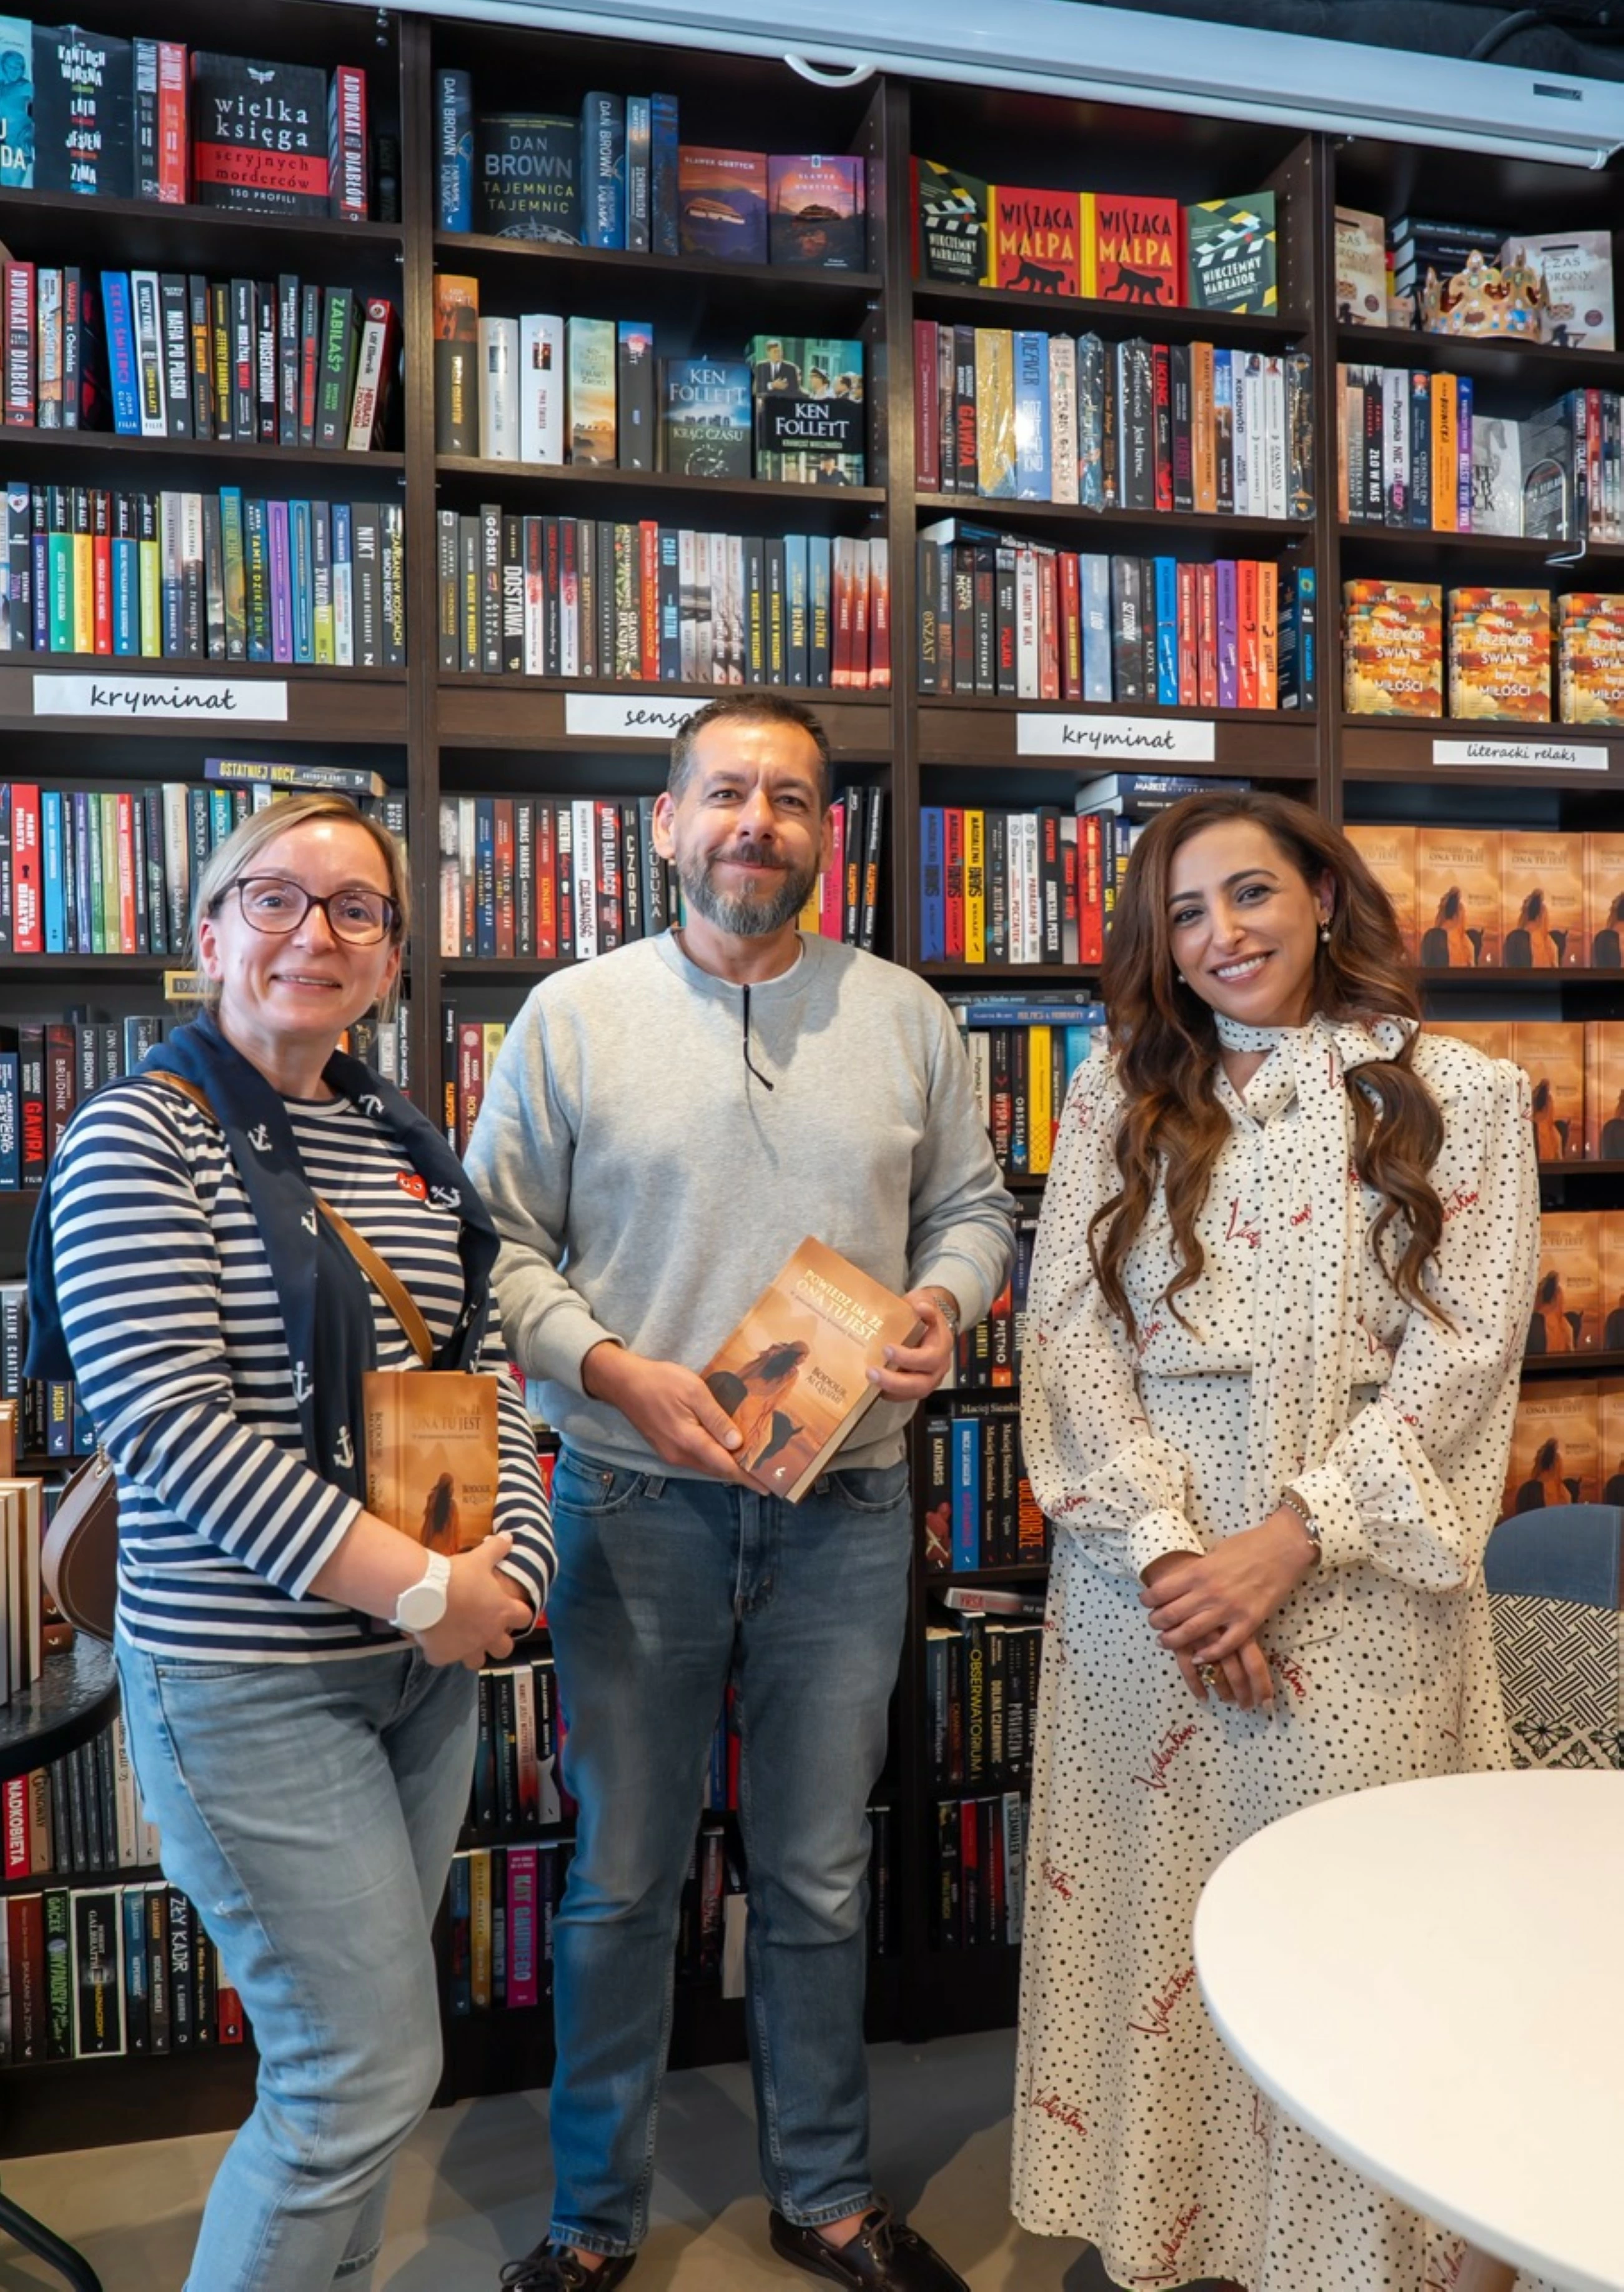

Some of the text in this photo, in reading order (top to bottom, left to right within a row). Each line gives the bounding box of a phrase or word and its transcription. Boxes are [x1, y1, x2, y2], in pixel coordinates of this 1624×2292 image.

[70, 98, 96, 117] LATO
[443, 77, 457, 104] DAN
[215, 96, 309, 124] wielka
[599, 101, 613, 125] DAN
[216, 115, 309, 151] księga
[344, 74, 365, 208] ADWOKAT DIABŁÓW
[443, 107, 456, 156] BROWN
[509, 136, 548, 151] DAN
[215, 149, 310, 173] seryjnych
[484, 154, 573, 179] BROWN
[600, 130, 613, 177] BROWN
[70, 162, 97, 184] ZIMA
[215, 168, 310, 189] morderców
[483, 182, 574, 197] TAJEMNICA
[230, 189, 297, 204] 150 PROFILI
[488, 199, 569, 214] TAJEMNIC
[1001, 199, 1074, 238] WISZĄCA
[1100, 207, 1172, 246] WISZĄCA
[1000, 229, 1074, 260] MAŁPA
[1100, 237, 1173, 267] MAŁPA
[1203, 257, 1262, 283] NIKCZEMNY
[1204, 273, 1255, 295] NARRATOR
[111, 284, 124, 323] SEKTA
[10, 270, 31, 407] ADWOKAT DIABŁÓW
[167, 310, 187, 399] MAFIA PO POLSKU
[690, 369, 726, 384] KEN
[1022, 337, 1040, 386] DEAVER
[669, 383, 746, 405] FOLLETT
[1157, 363, 1169, 405] KING
[775, 418, 849, 438] FOLLETT
[795, 403, 829, 419] KEN
[673, 428, 743, 441] KRĄG CZASU
[958, 404, 975, 467] GAWRA
[1394, 446, 1403, 464] NIC
[1370, 469, 1380, 480] W
[1370, 482, 1380, 503] NAS
[252, 534, 260, 568] TAMTE
[357, 526, 375, 560] NIKT
[486, 516, 499, 566] GÓRSKI
[384, 548, 392, 623] SIMON BECKETT
[504, 565, 523, 637] DOSTAWA
[1022, 583, 1032, 621] SAMOTNY
[394, 595, 403, 646] KOŚCIACH
[1122, 602, 1136, 642] SZTORM
[1371, 628, 1425, 642] PRZEKÓR
[1390, 612, 1407, 623] Na
[628, 612, 638, 660] GŁODNE
[1476, 633, 1533, 648] PRZEKÓR
[1374, 678, 1423, 693] MIŁOŚCI
[220, 762, 268, 780] OSTATNIEJ
[1467, 744, 1577, 762] literacki relaks
[16, 808, 25, 852] MIASTA
[518, 807, 530, 879] THOMAS HARRIS
[972, 816, 981, 863] MAGDALENA
[602, 808, 615, 895] DAVID BALDACCI
[626, 835, 637, 926] CZORT
[1011, 900, 1021, 944] POCZĄTEK
[106, 1029, 117, 1051] DAN
[83, 1029, 94, 1089] DAN BROWN
[56, 1058, 65, 1111] BRUDNIK
[467, 1096, 477, 1118] ROK
[24, 1101, 43, 1163] GAWRA
[804, 1269, 852, 1307] POWIEDZ
[797, 1279, 878, 1341] ONA TU JEST
[994, 1319, 1006, 1364] PIĘTNO
[7, 1346, 19, 1393] CHATTAM
[52, 1385, 65, 1422] JAGODA
[962, 1402, 988, 1415] Maciej
[441, 1417, 481, 1431] TU JEST
[985, 1426, 996, 1456] Maciej
[1001, 1424, 1012, 1454] Maciej
[970, 1649, 982, 1772] OBSERWATORIUM
[1133, 1722, 1197, 1790] Valentino
[7, 1780, 24, 1866] NADKOBIETA
[47, 1897, 62, 1933] GACEK
[513, 1875, 532, 1981] KAT GAUDIEGO
[88, 1910, 101, 1970] GALBRAITH
[171, 1897, 189, 1972] ZŁY KADR
[1131, 2201, 1203, 2282] Valentino
